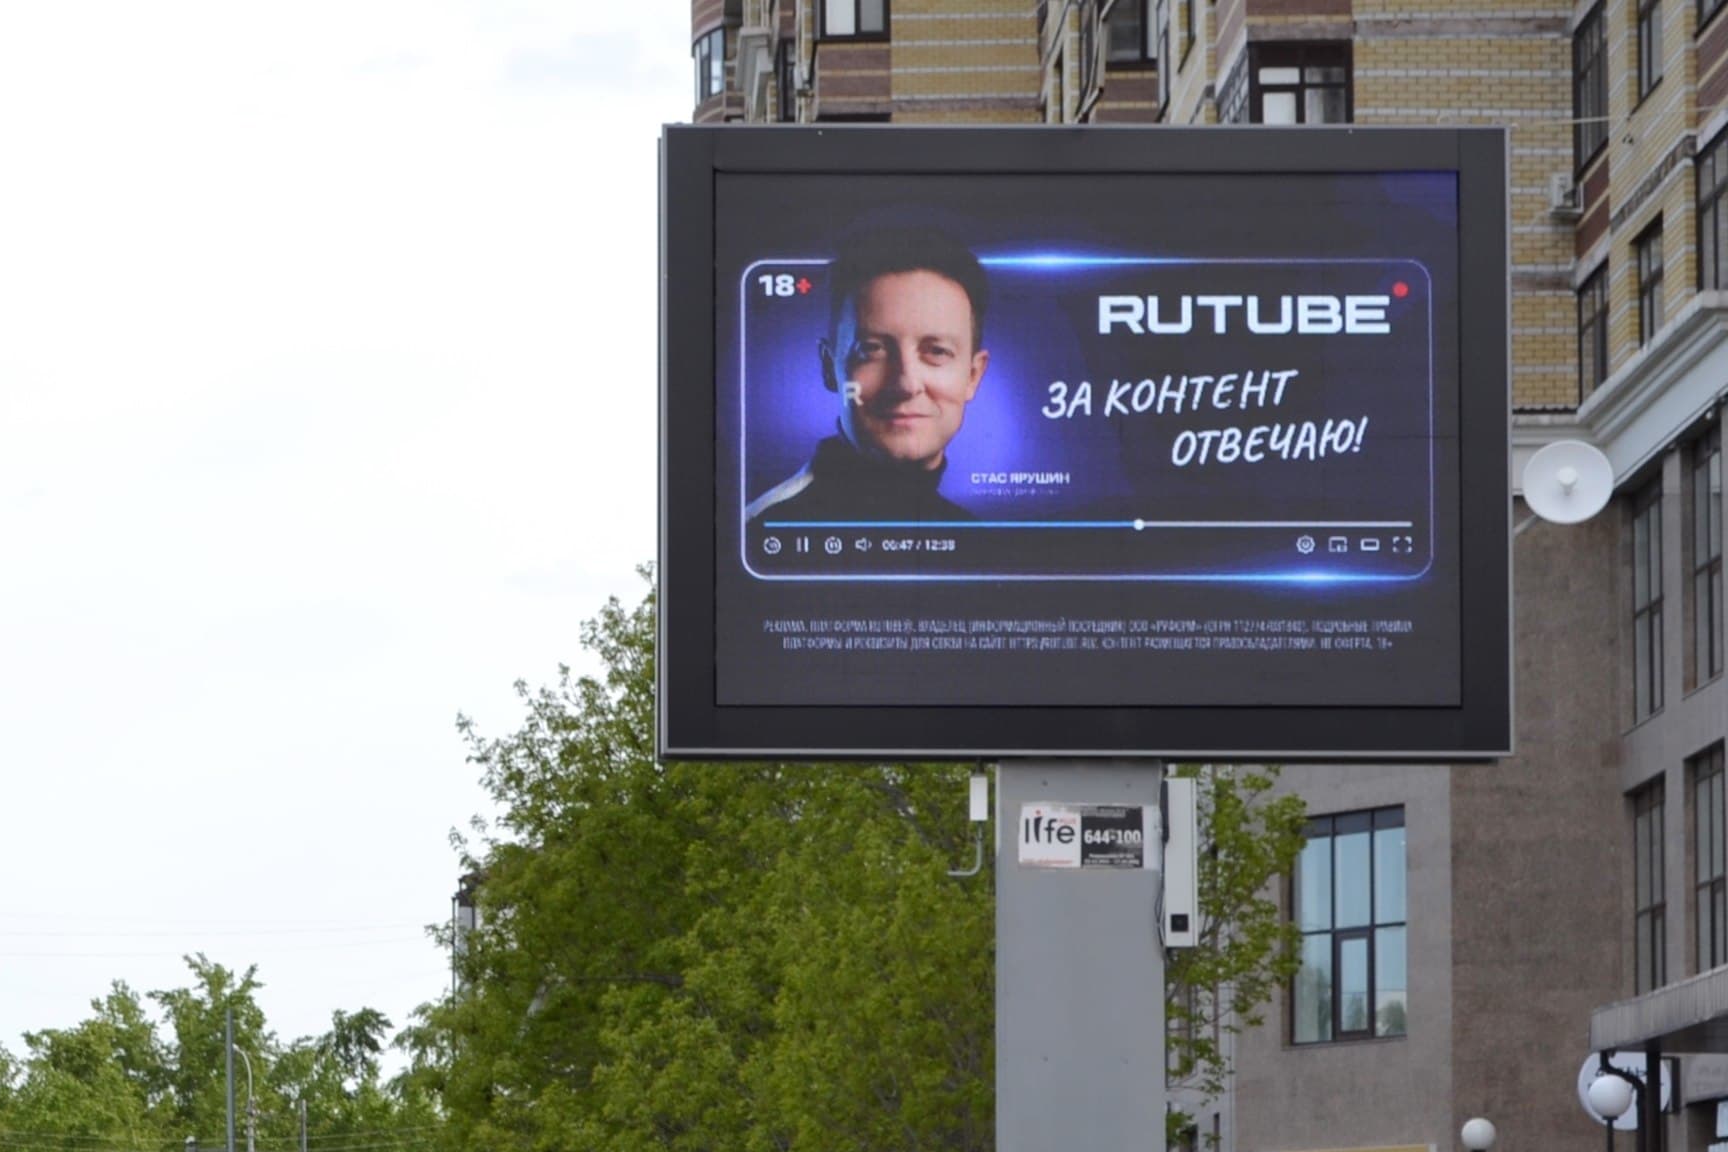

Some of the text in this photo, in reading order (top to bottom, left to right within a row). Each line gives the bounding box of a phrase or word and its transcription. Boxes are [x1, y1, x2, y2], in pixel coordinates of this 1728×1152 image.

[759, 274, 812, 297] 18+
[1098, 295, 1391, 334] RUTUBE
[1041, 369, 1299, 420] ЗА КОНТЕНТ
[1171, 416, 1369, 466] ОТВЕЧАЮ!
[970, 472, 1071, 484] СТАС ЯРУШИН
[1024, 810, 1075, 844] life
[1083, 829, 1142, 844] 644-100
